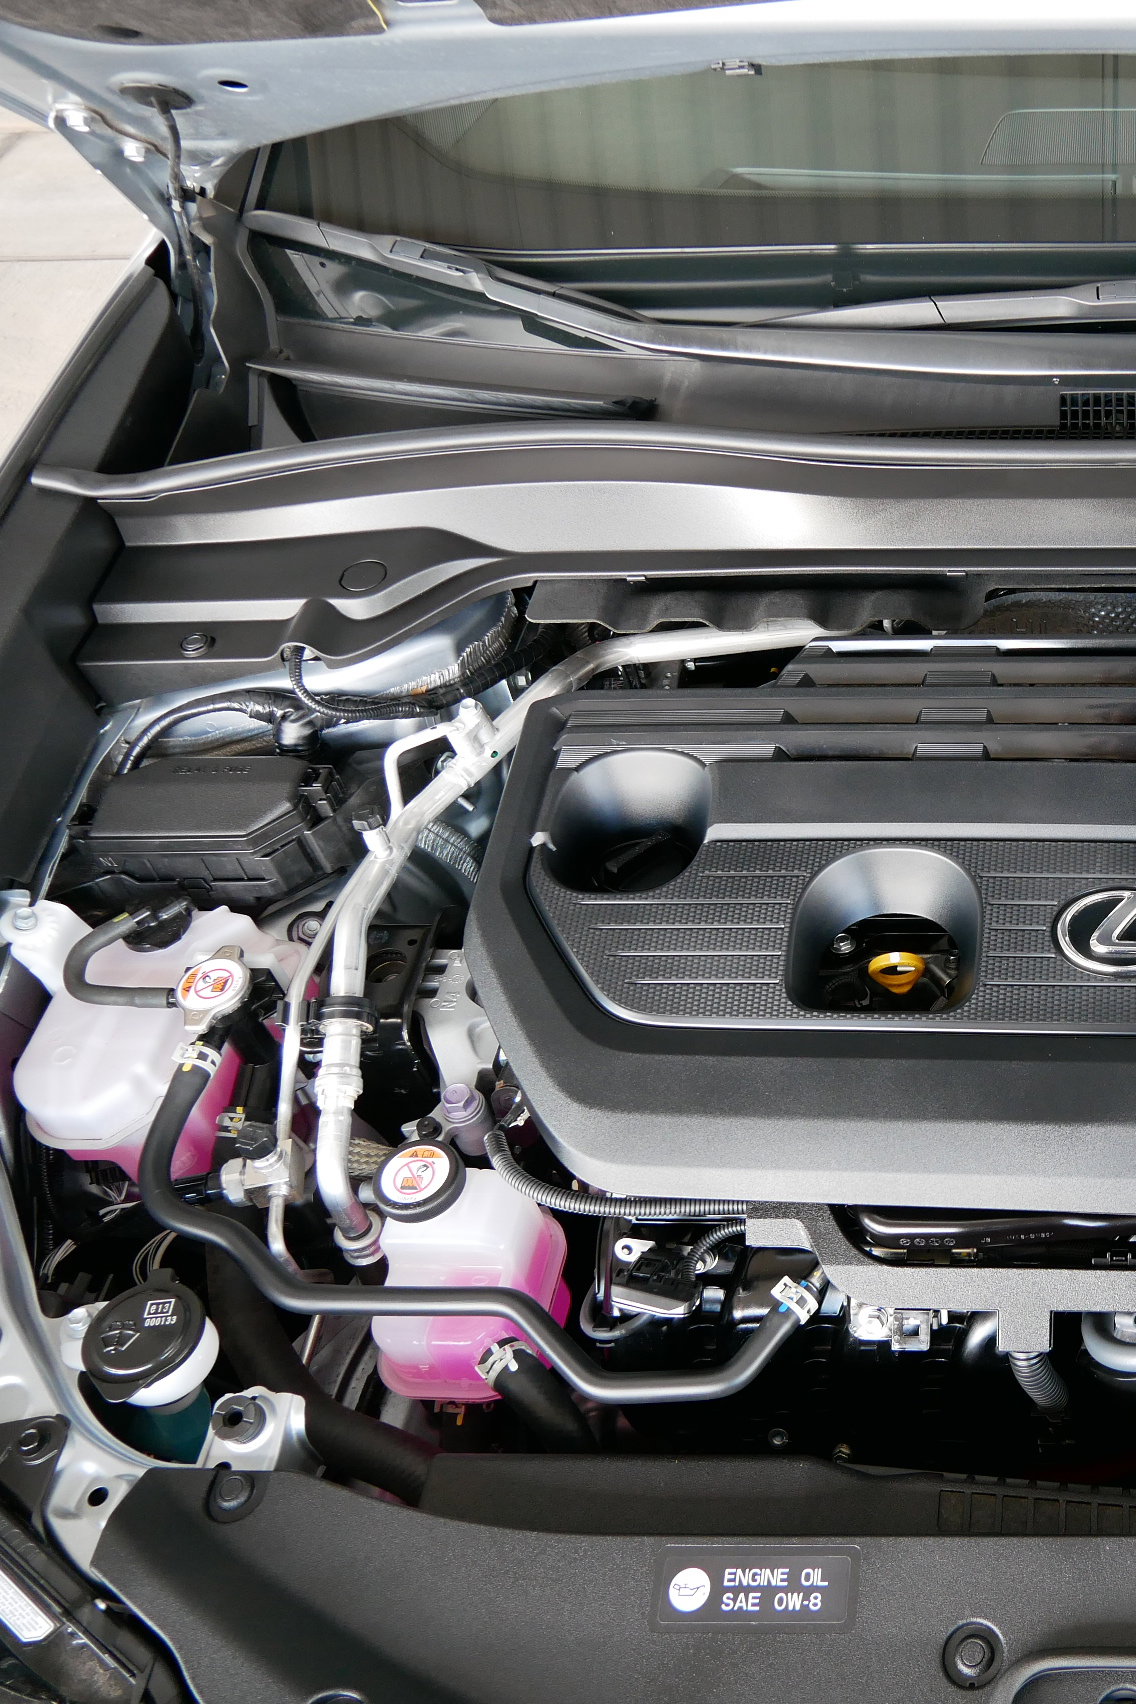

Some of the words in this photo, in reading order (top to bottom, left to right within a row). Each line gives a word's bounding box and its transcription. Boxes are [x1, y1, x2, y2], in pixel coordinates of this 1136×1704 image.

[150, 1303, 170, 1314] e13
[144, 1315, 177, 1327] 000133
[723, 1568, 789, 1586] ENGINE
[801, 1568, 829, 1586] OIL
[721, 1592, 761, 1611] SAE
[773, 1592, 822, 1611] 0W-8
